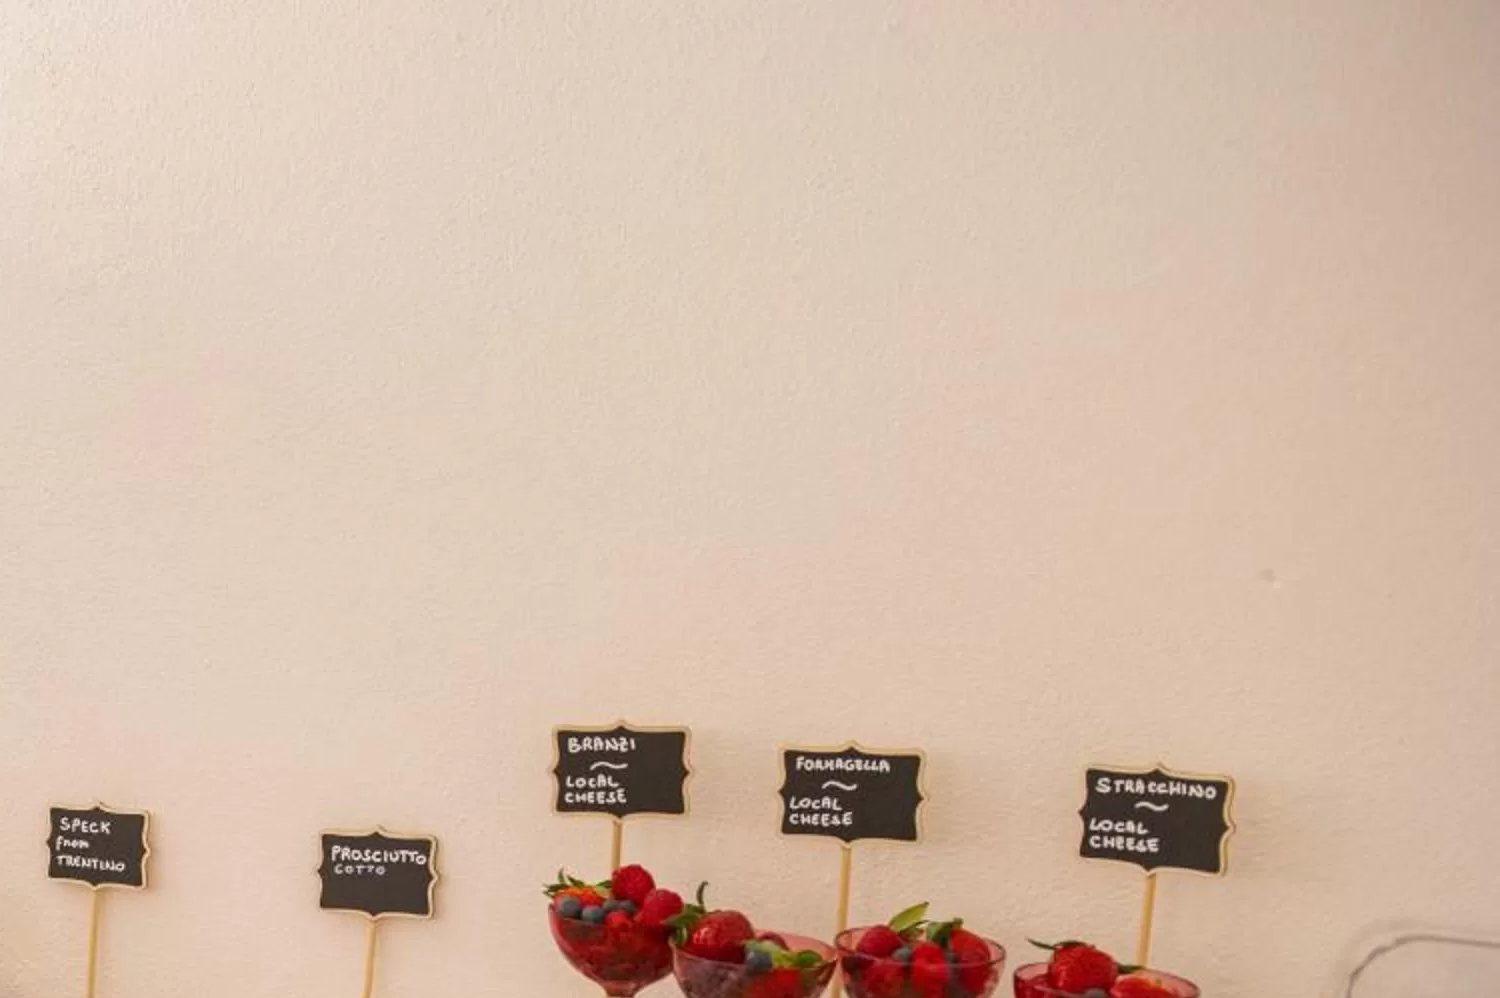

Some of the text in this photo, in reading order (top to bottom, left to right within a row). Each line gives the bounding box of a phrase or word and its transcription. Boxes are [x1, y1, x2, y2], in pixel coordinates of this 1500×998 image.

[567, 737, 636, 753] BRANZI
[795, 756, 890, 773] FORMAGELLA
[566, 773, 620, 788] LOCAL
[1095, 777, 1218, 800] STRACCHINO
[564, 788, 627, 804] CHEESE
[789, 796, 843, 811] LOCAL
[59, 817, 112, 835] SPECK
[789, 811, 853, 827] CHEESE
[1089, 817, 1150, 835] LOCAL
[1088, 834, 1160, 853] CHEESE
[56, 854, 126, 873] TRENTINO
[330, 845, 427, 865] PROSCIUTTO
[334, 863, 387, 876] COTTO
